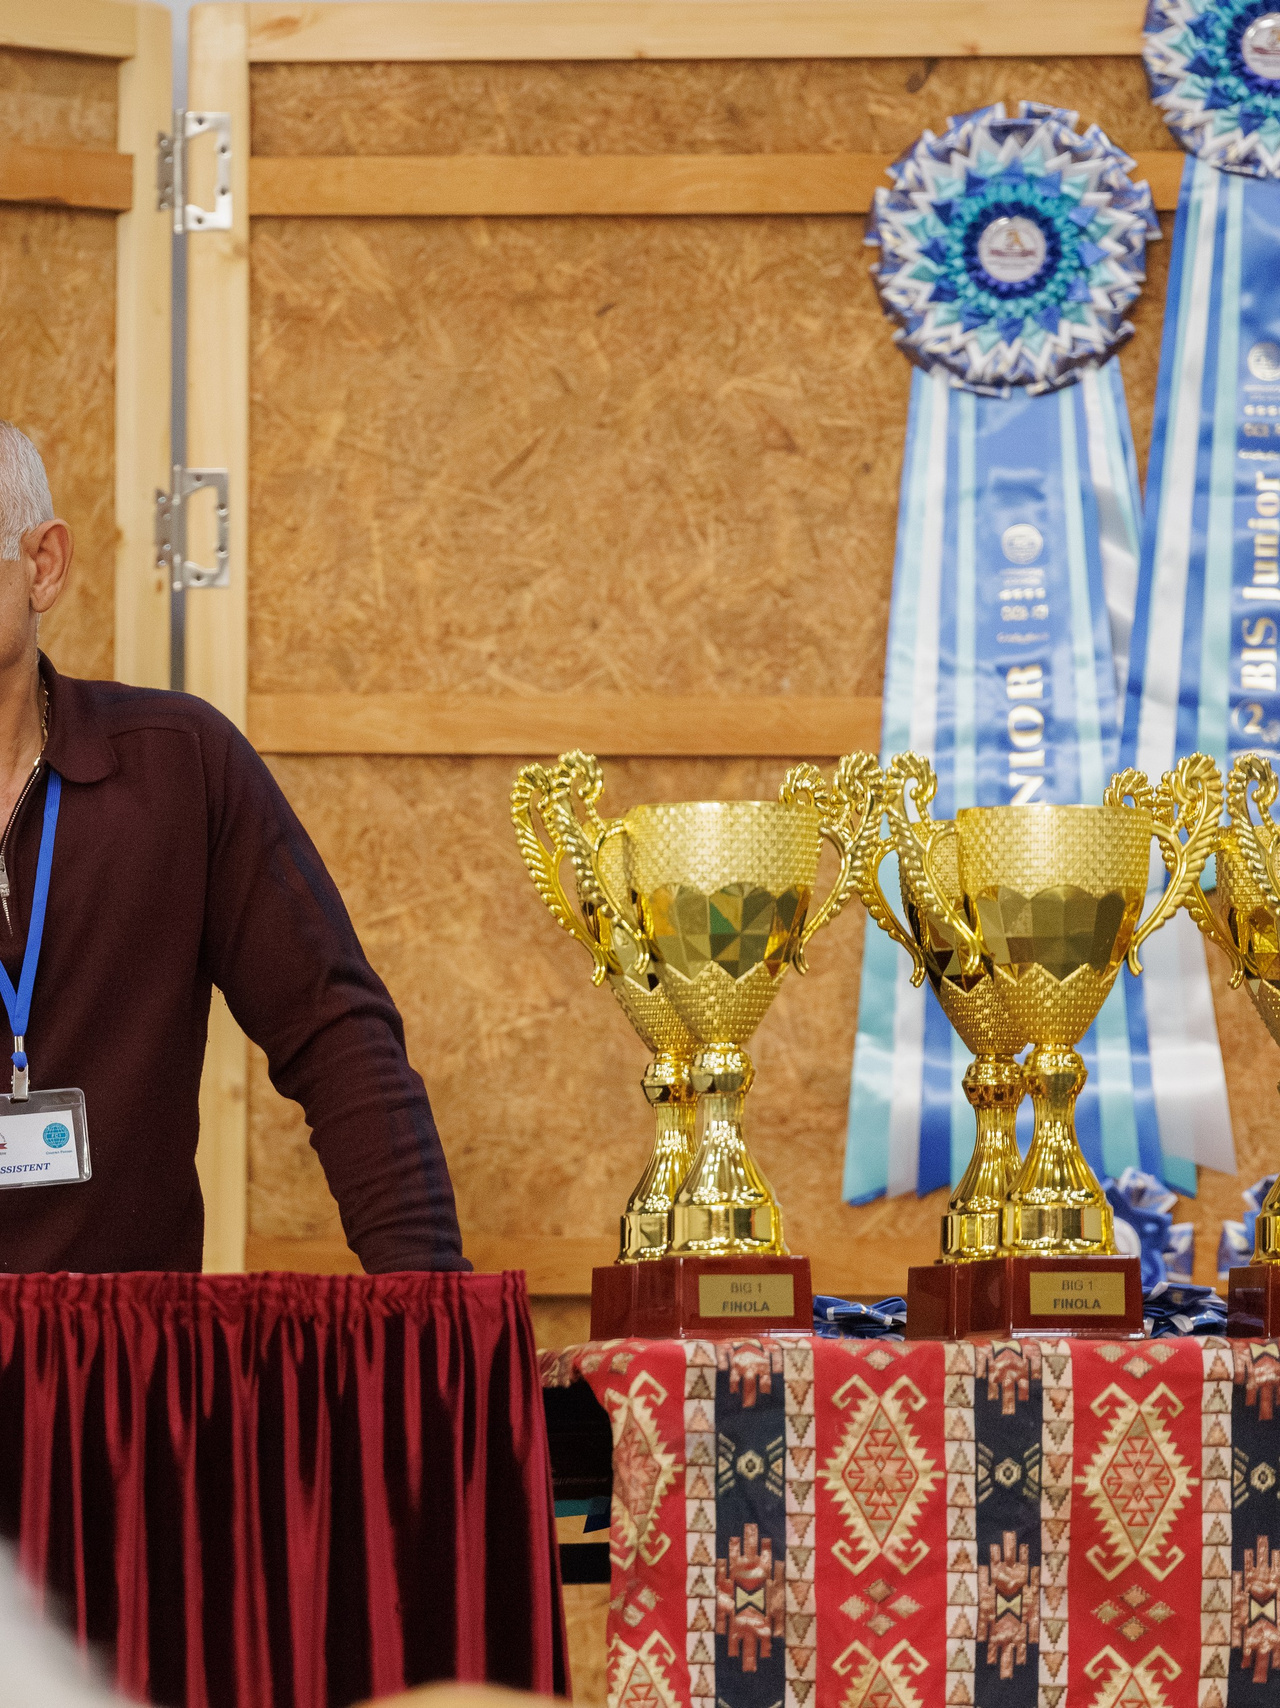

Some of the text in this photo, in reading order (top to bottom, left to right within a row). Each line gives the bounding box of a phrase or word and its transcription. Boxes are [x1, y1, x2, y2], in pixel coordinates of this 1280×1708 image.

[1241, 470, 1280, 601] Junior
[1240, 616, 1278, 692] BIS
[730, 1282, 762, 1294] BIG 1
[1061, 1280, 1094, 1292] BIG 1
[722, 1301, 770, 1312] FINOLA
[1053, 1298, 1102, 1310] FINOLA
